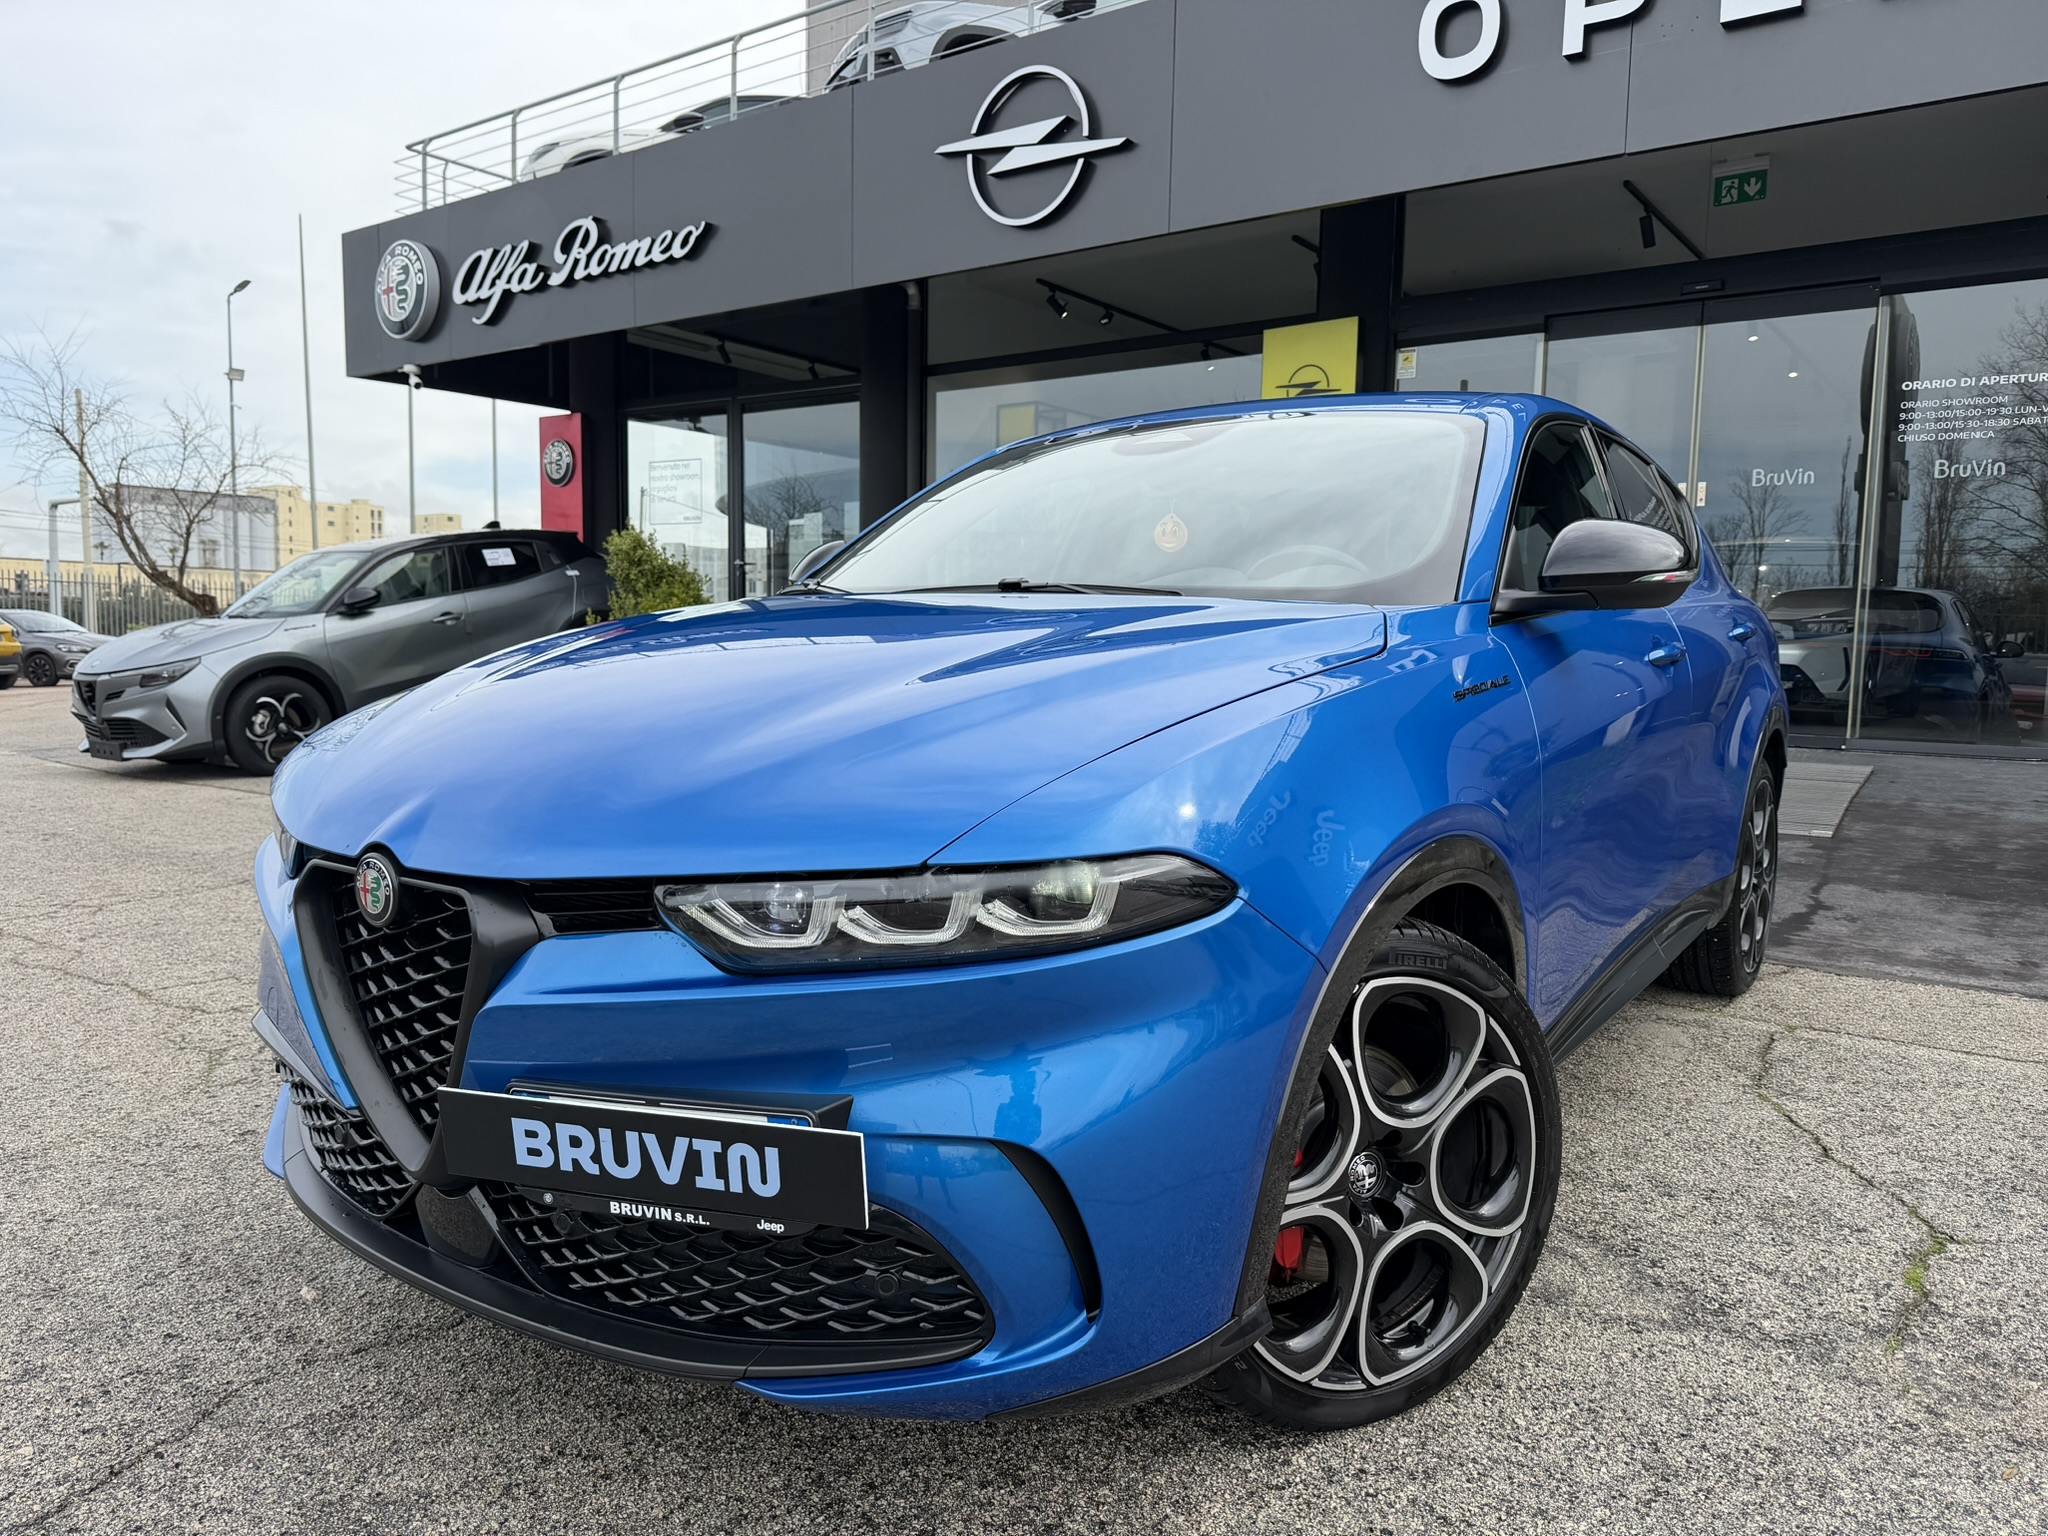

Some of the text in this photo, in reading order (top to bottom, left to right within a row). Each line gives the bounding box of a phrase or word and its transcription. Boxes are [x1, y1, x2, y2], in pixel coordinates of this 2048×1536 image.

[1418, 0, 1802, 80] OP
[394, 245, 424, 285] ROMEO
[452, 215, 706, 325] Alfa Romeo
[1901, 372, 2048, 391] ORARIO DI APERTUR
[1900, 396, 2009, 409] ORARIO SHOWROOM
[2013, 416, 2048, 426] SABAT
[1897, 430, 1995, 443] CHIUSO DOMENICA
[1751, 468, 1815, 487] BruVin
[1934, 459, 2006, 479] BruVin
[1453, 674, 1511, 703] SPECIALE
[1388, 947, 1447, 970] PIRELLI
[510, 1117, 782, 1198] BRUVIN
[609, 1201, 711, 1226] BRUVIN S.R.L.
[756, 1219, 785, 1234] Jeep
